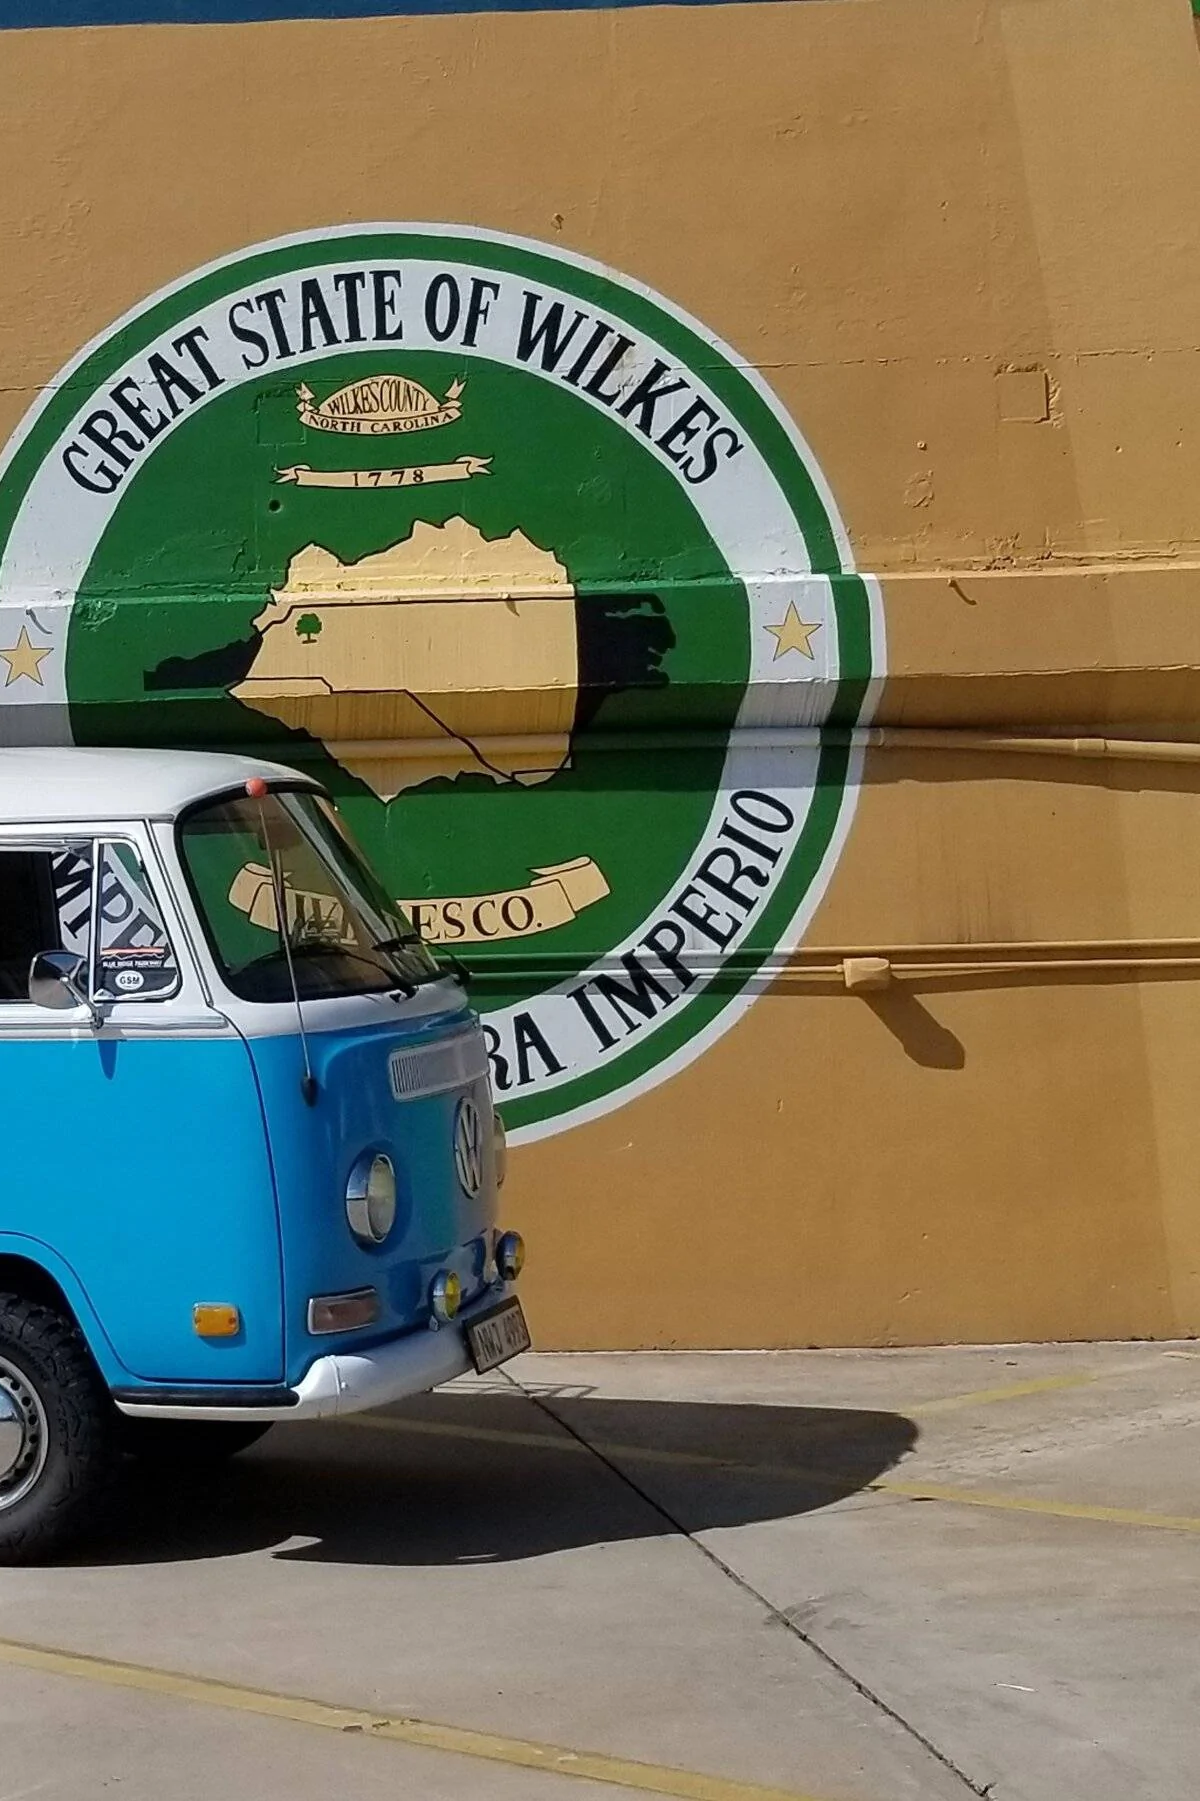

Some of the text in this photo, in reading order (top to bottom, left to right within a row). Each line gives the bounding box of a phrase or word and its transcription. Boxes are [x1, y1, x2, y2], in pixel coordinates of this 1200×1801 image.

[61, 269, 744, 496] GREAT STATE OF WILKES
[327, 379, 432, 415] WILKES COUNTY
[308, 412, 454, 433] NORTH CAROLINA
[352, 469, 424, 487] 1778
[567, 789, 795, 1054] IMPERIO
[119, 976, 140, 985] GSM
